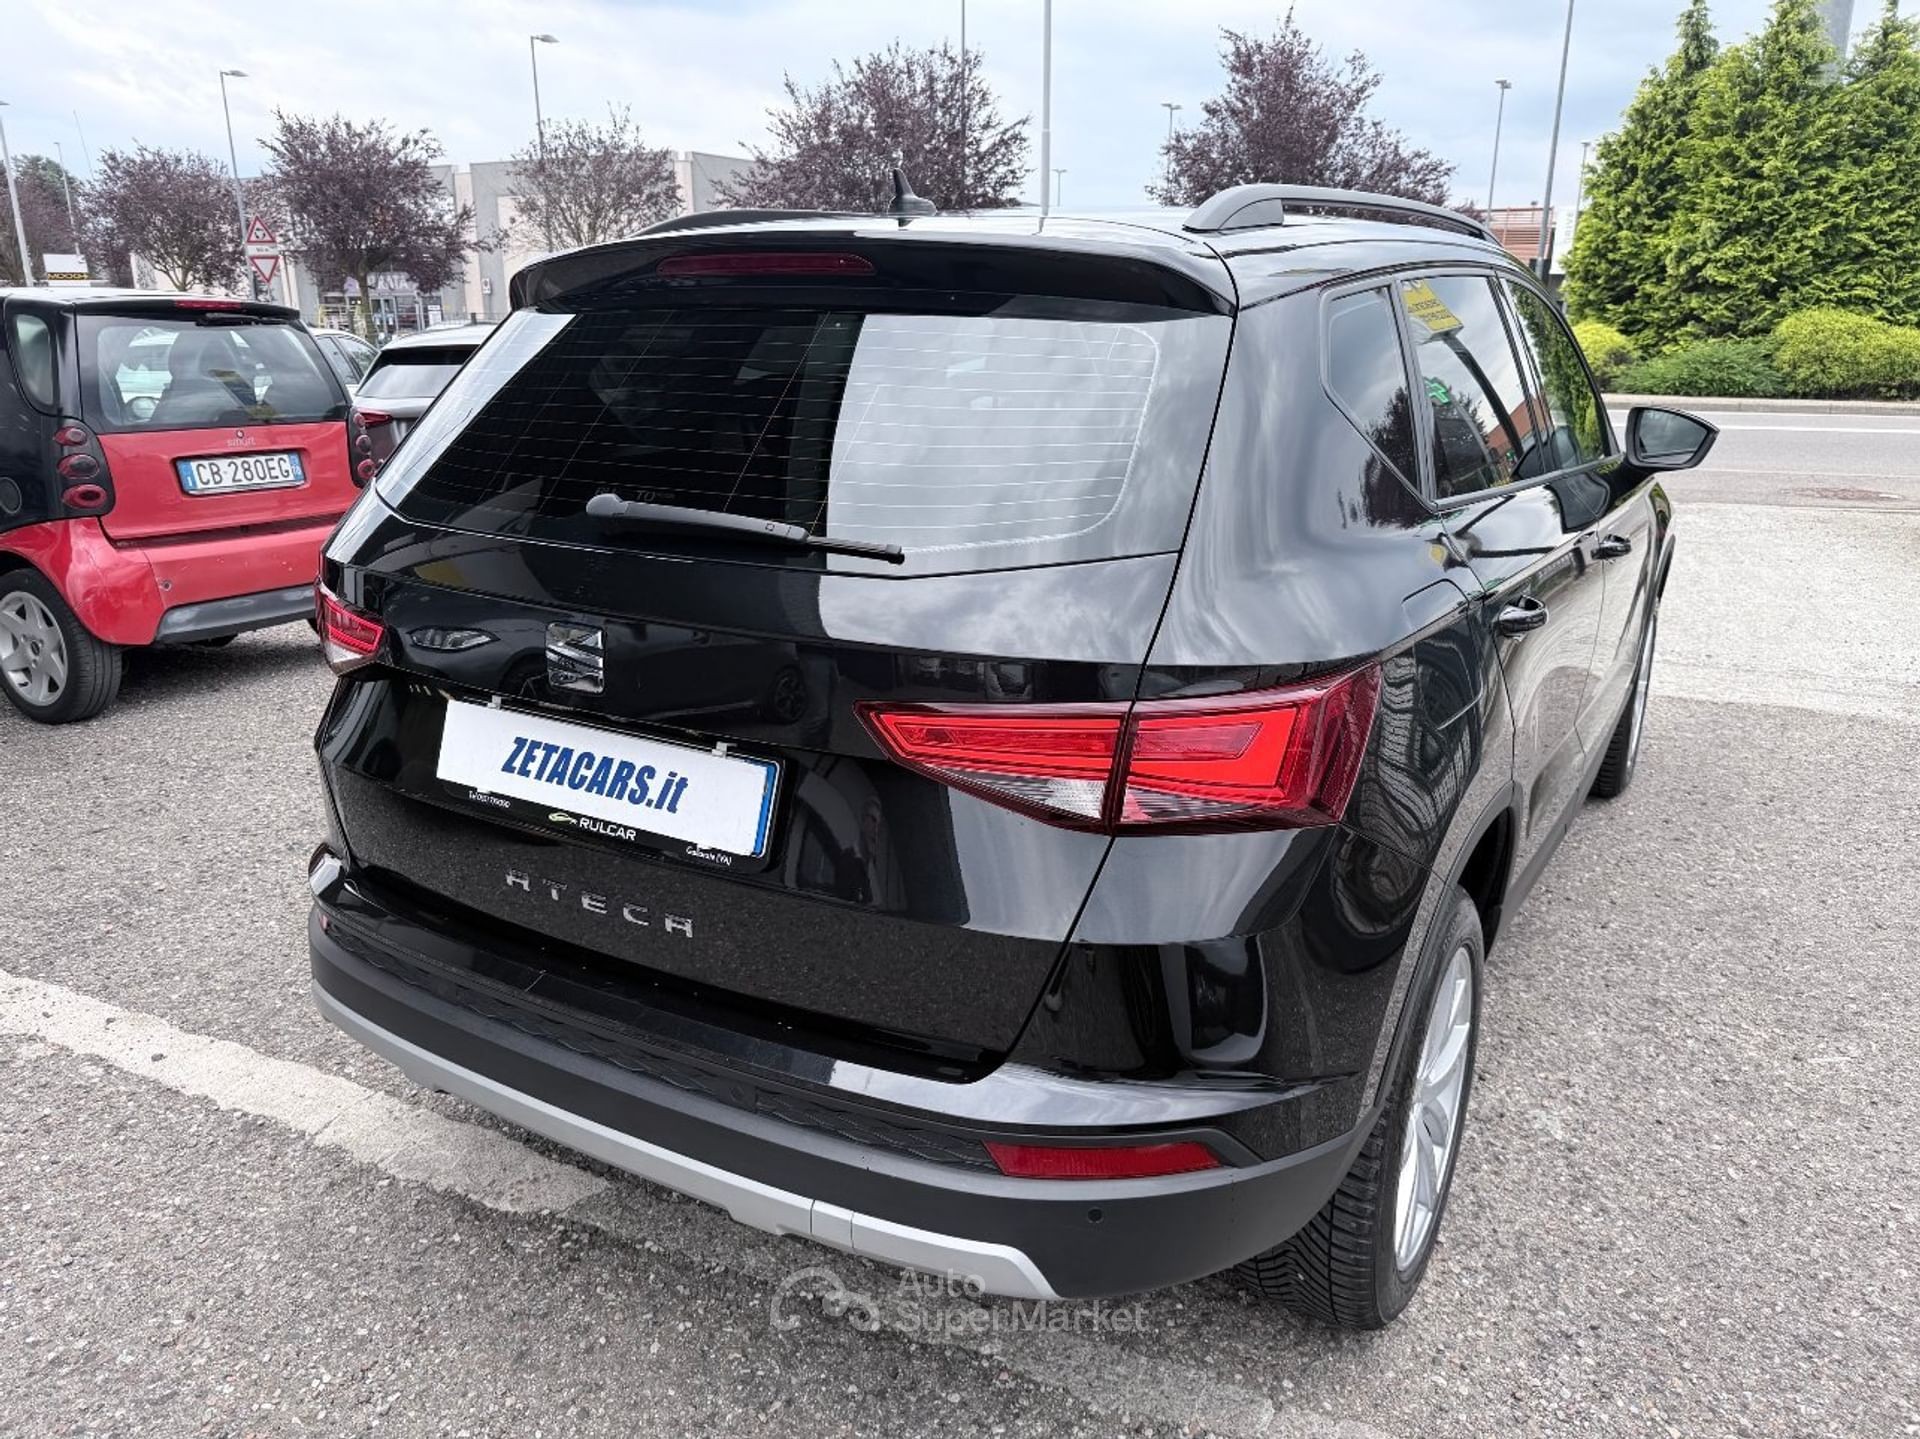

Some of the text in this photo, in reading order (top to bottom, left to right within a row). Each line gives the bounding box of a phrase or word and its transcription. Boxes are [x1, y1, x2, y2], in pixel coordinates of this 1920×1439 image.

[227, 437, 256, 447] smart
[196, 461, 223, 486] CB
[228, 458, 290, 483] 280EG
[501, 736, 688, 814] ZETACARS.it
[579, 816, 636, 841] RULCAR
[506, 868, 693, 938] ATECA
